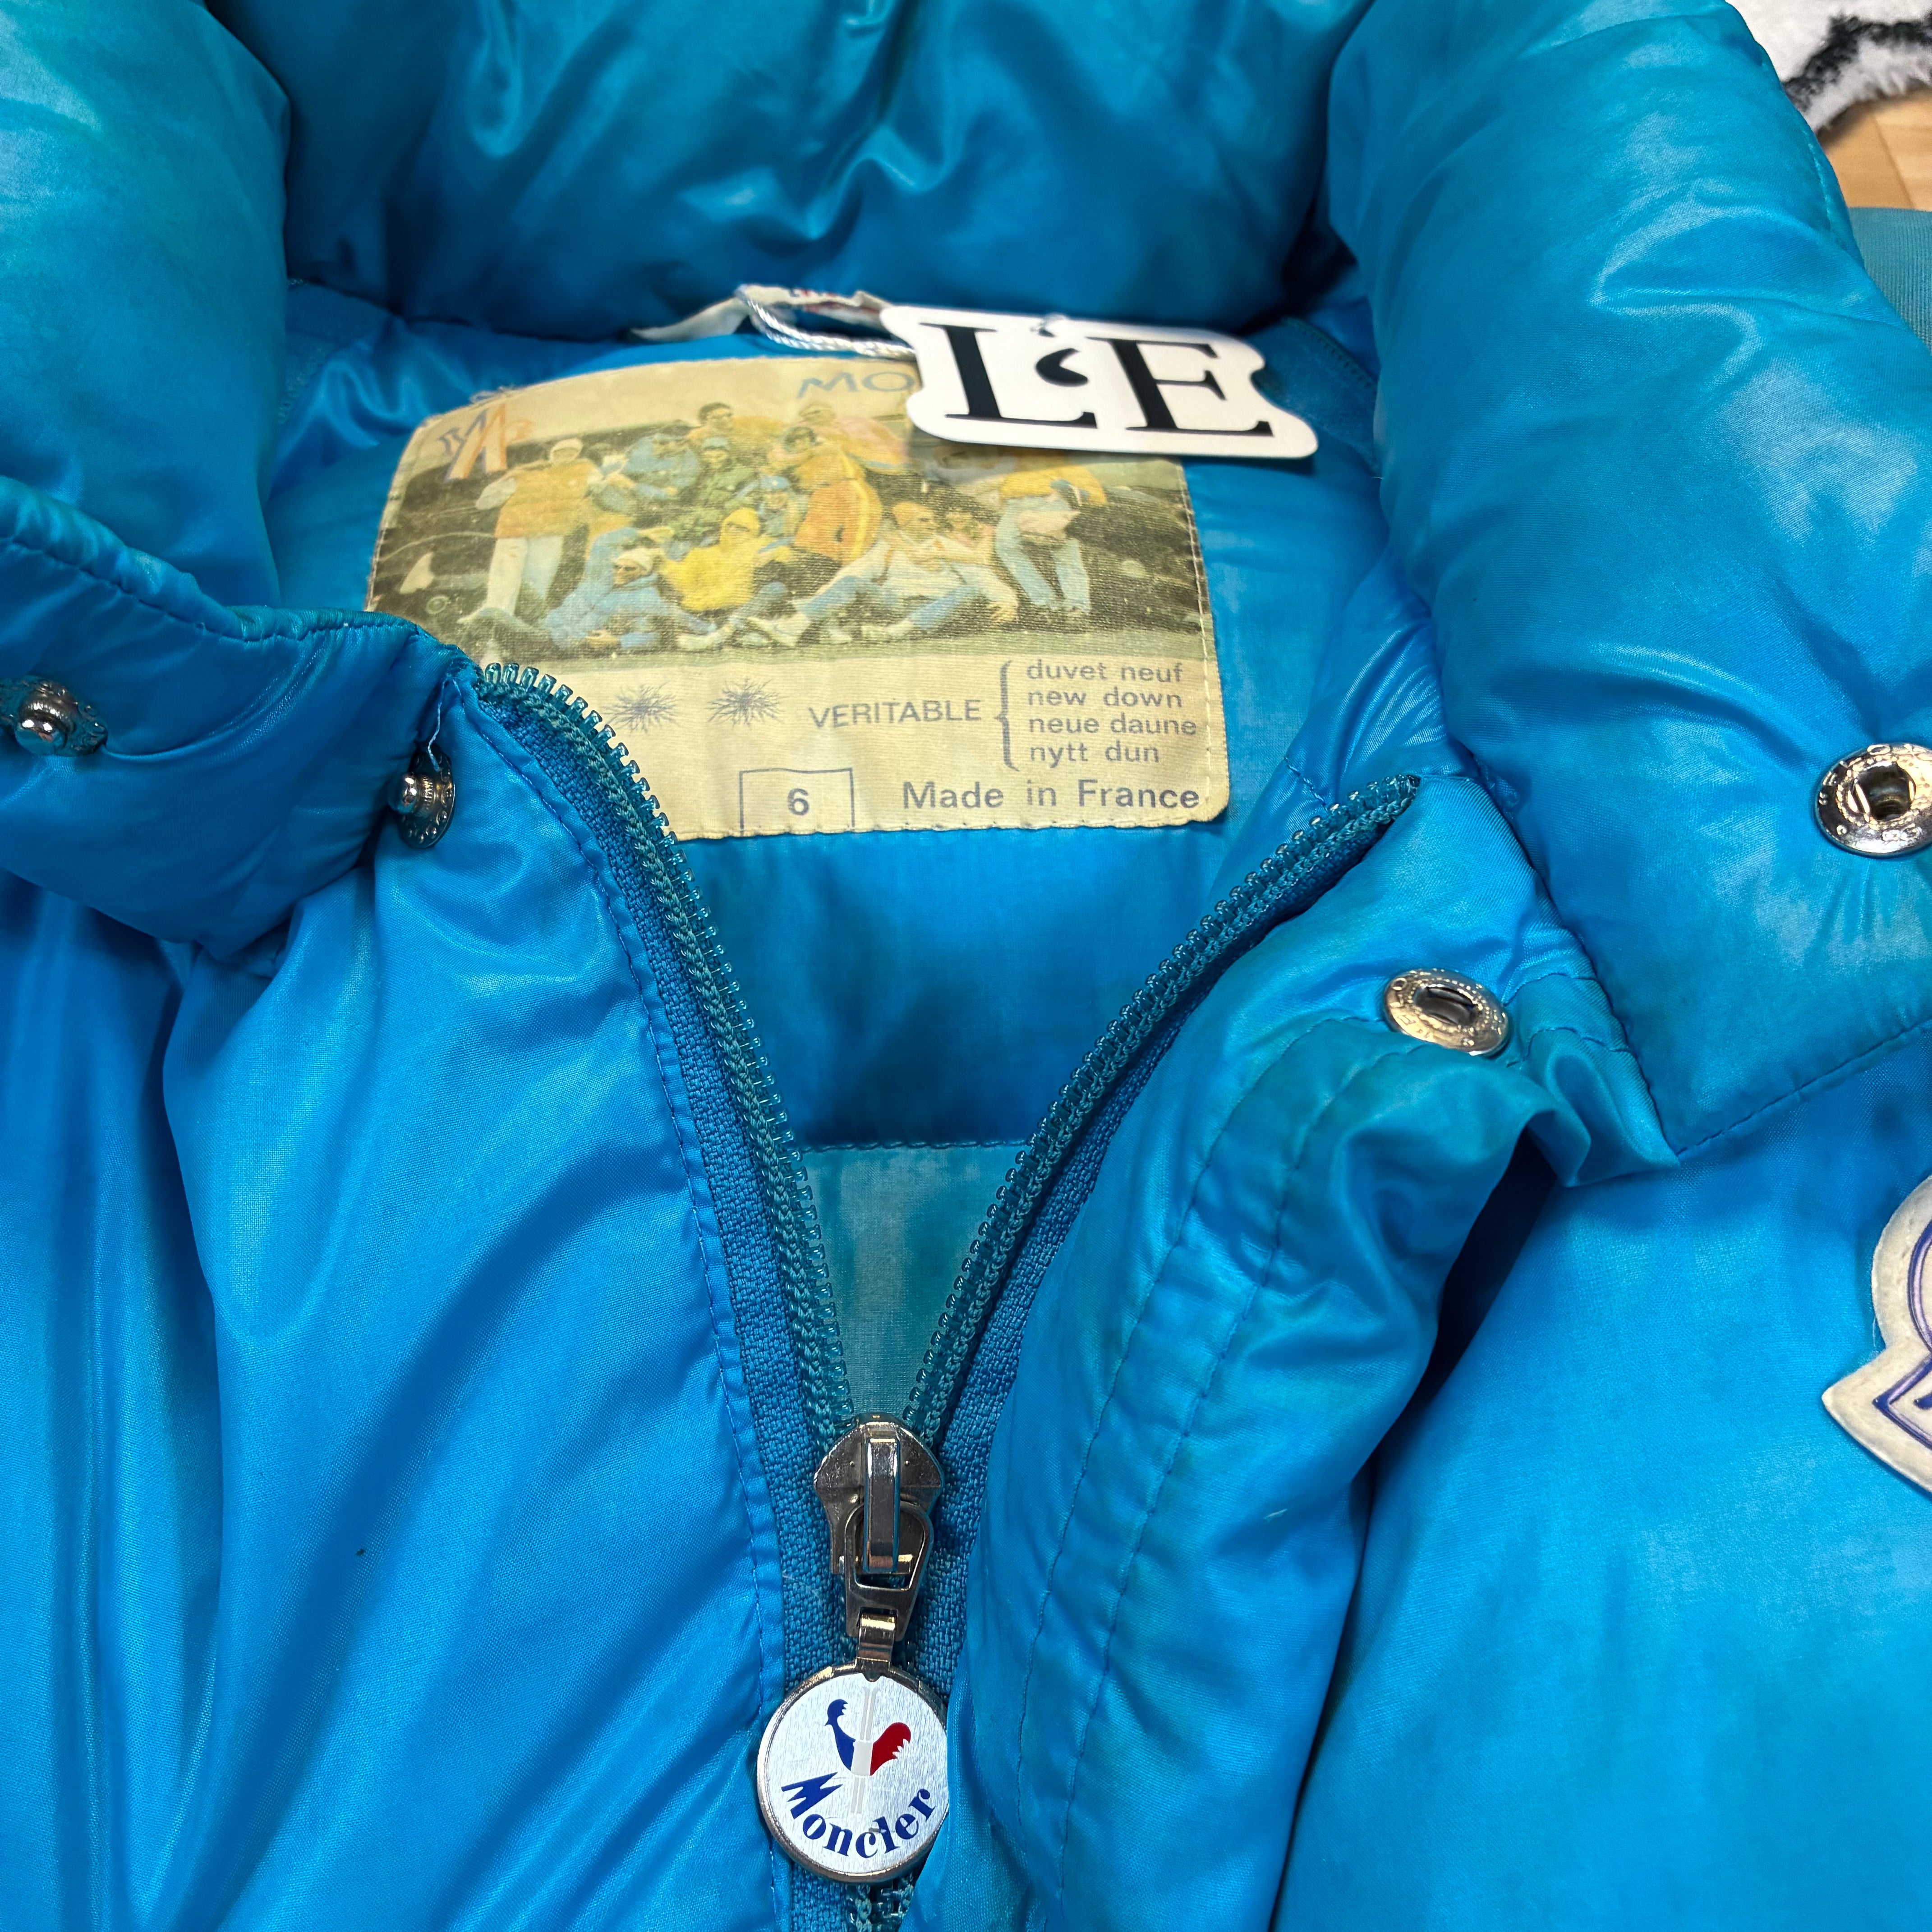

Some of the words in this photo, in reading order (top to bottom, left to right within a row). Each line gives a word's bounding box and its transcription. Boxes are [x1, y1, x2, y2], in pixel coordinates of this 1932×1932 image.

[797, 371, 915, 399] MO
[1026, 659, 1108, 680] duvet
[1121, 662, 1183, 682] neuf
[1028, 690, 1086, 706] new
[1103, 686, 1182, 708] down
[808, 699, 982, 728] VERITABLE
[1029, 717, 1099, 734] neue
[1110, 712, 1196, 735] daune
[1030, 743, 1088, 768] nytt
[1104, 740, 1159, 763] dun
[787, 788, 809, 816] 6
[903, 781, 1004, 809] Made
[1026, 779, 1057, 806] in
[1078, 779, 1200, 809] France
[781, 1772, 936, 1858] Moncler
